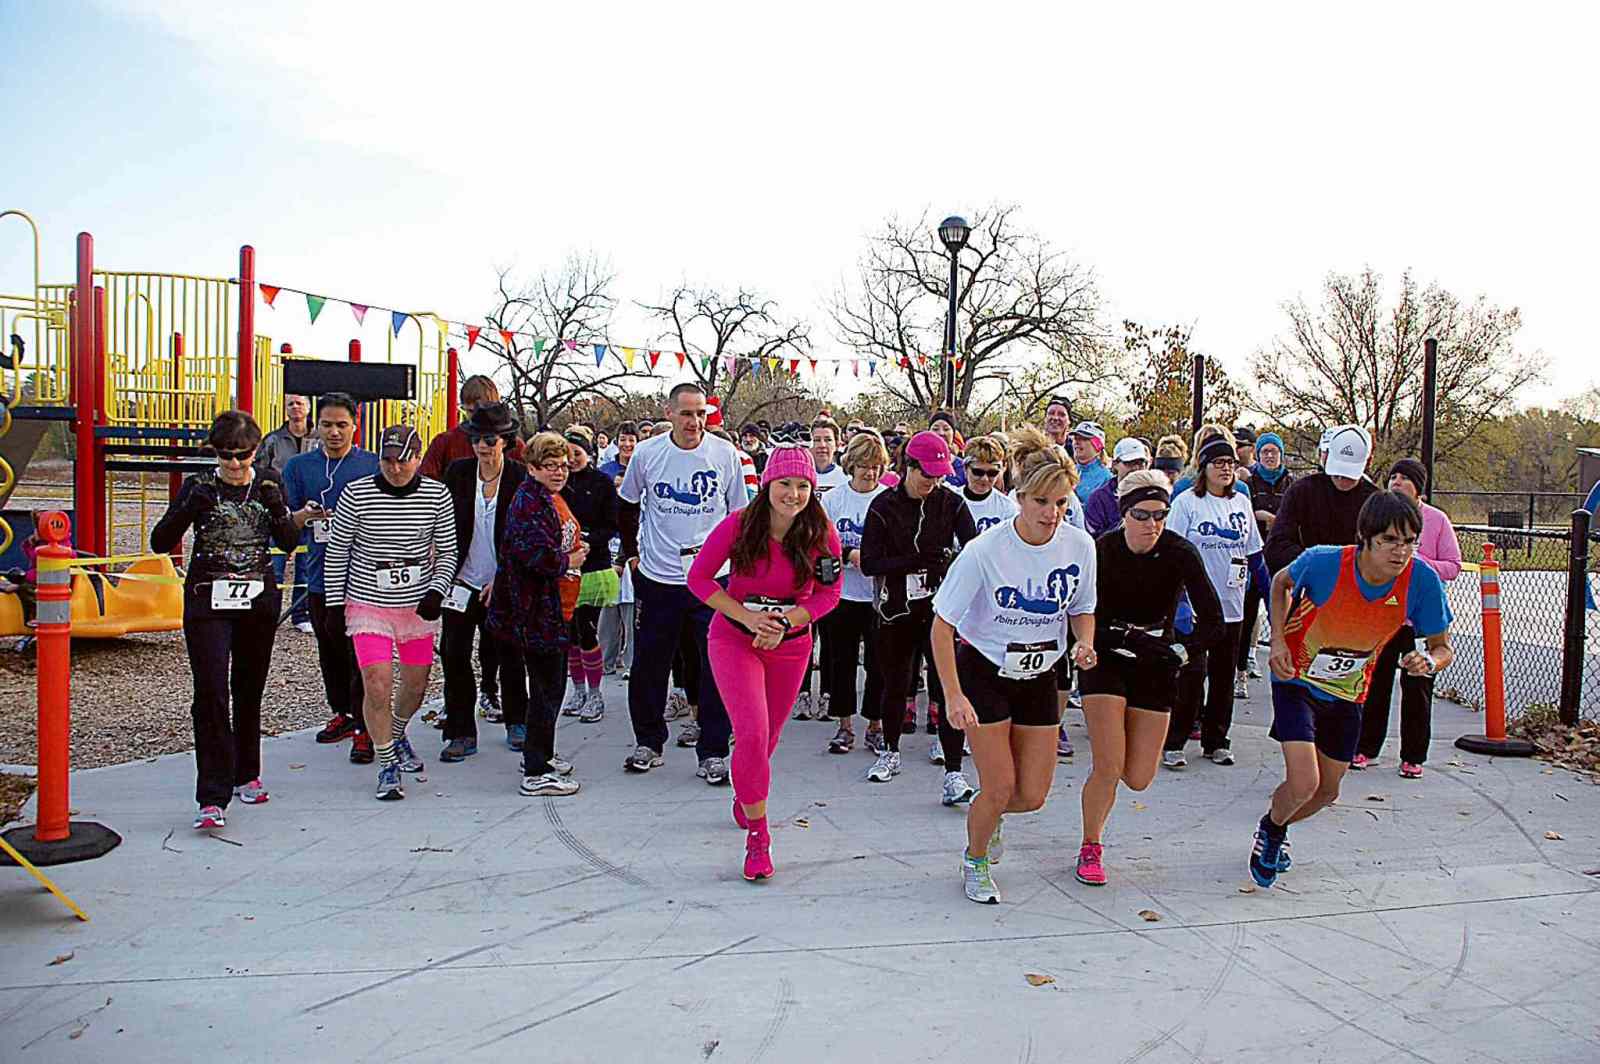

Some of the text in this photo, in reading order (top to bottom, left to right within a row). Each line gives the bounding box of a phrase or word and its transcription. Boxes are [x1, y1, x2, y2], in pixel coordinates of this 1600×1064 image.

[389, 568, 411, 585] 56
[228, 582, 250, 599] 77
[1019, 653, 1044, 671] 40
[1327, 657, 1356, 672] 39
